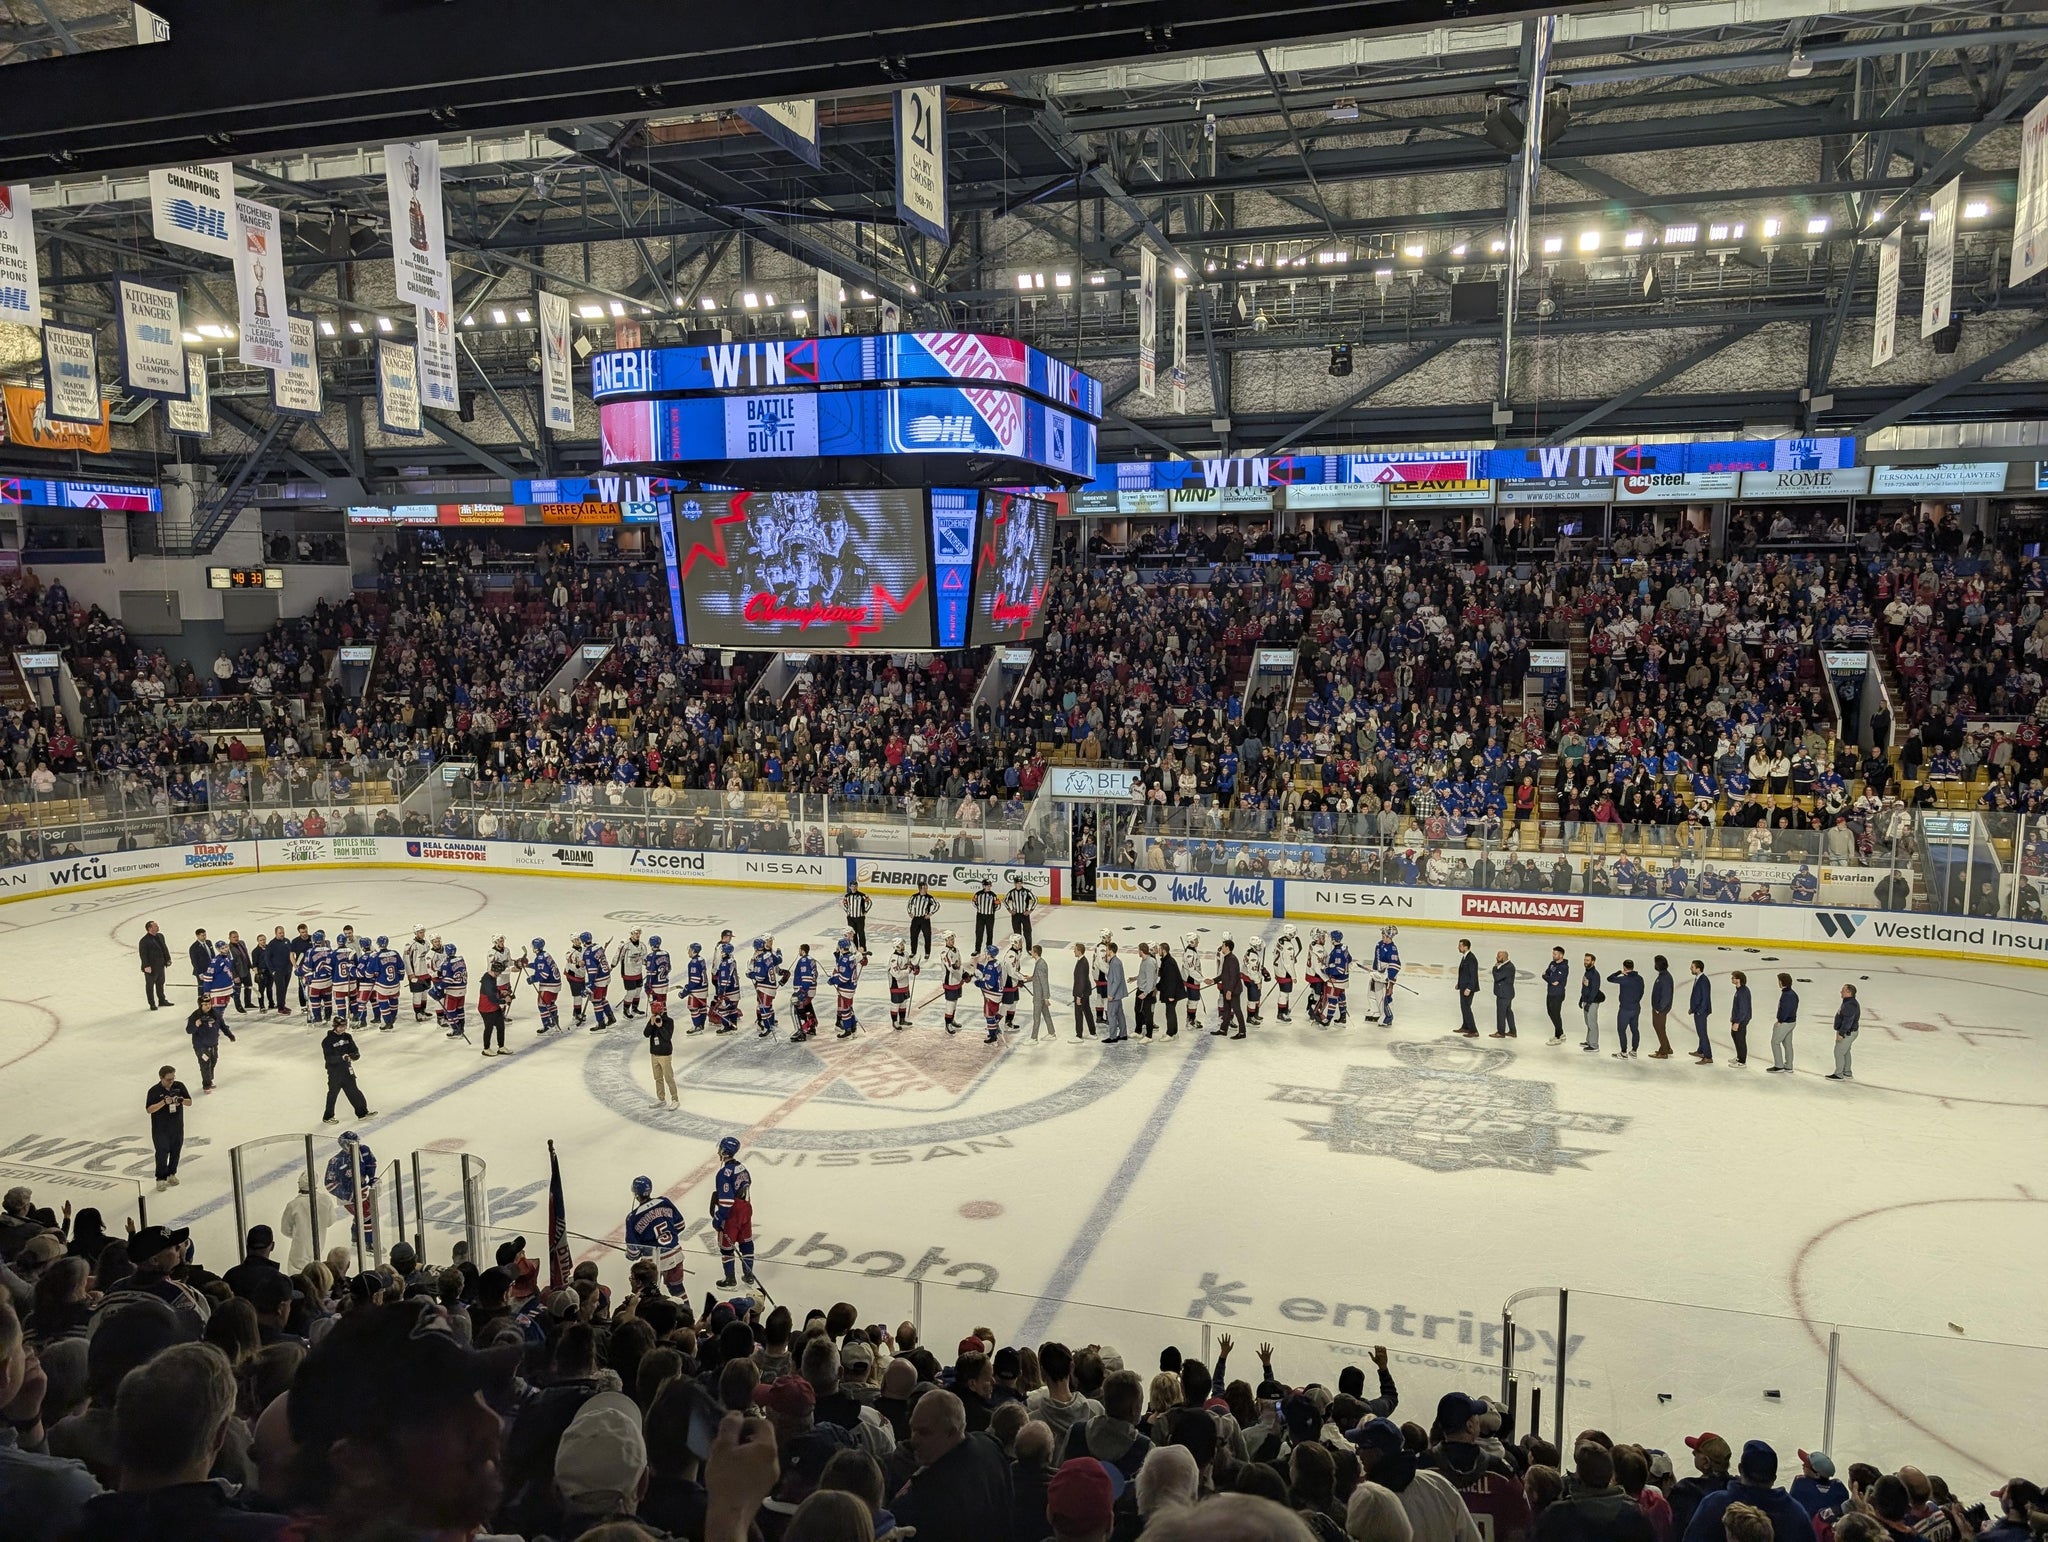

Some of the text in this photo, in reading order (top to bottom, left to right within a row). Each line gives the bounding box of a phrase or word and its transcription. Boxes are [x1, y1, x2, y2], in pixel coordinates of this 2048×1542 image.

[910, 92, 934, 157] 21
[912, 153, 932, 174] GARY
[167, 173, 221, 199] CHAMPIONS
[910, 166, 936, 194] CROSBY
[236, 202, 273, 221] KITCHENER
[239, 214, 271, 230] RANGERS
[412, 272, 434, 287] LEAGUE
[125, 289, 175, 309] KITCHENER
[407, 282, 441, 301] CHAMPIONS
[131, 303, 172, 321] RANGERS
[48, 331, 93, 348] KITCHENER
[251, 327, 276, 340] LEAGUE
[244, 335, 284, 349] CHAMPIONS
[53, 344, 89, 359] RANGERS
[136, 362, 180, 376] CHAMPIONS
[142, 355, 171, 368] LEAGUE
[708, 341, 786, 388] WIN
[63, 381, 86, 391] MAJOR
[284, 379, 310, 388] DIVISION
[1046, 355, 1070, 406] WIN
[281, 385, 316, 396] CHAMPIONS
[57, 394, 96, 406] CHAMPIONS
[746, 398, 795, 420] BATTLE
[748, 430, 796, 453] BUILT
[1539, 445, 1616, 478] WIN
[1202, 457, 1270, 488] WIN
[1652, 473, 1685, 486] steel
[1777, 472, 1832, 487] ROME
[1879, 471, 2001, 482] PERSONAL INJURY LAWYERS
[597, 476, 651, 503] WIN
[1174, 487, 1217, 503] MNP
[1310, 483, 1381, 492] MILLER THOMSON
[473, 503, 504, 512] Home
[542, 502, 617, 522] PERFEXIA.CA
[459, 516, 485, 524] building
[939, 519, 969, 528] KITCHENER
[250, 572, 262, 584] 33
[743, 592, 868, 632] Champions
[1098, 773, 1130, 790] BFL
[193, 844, 229, 856] Mary
[332, 838, 376, 847] BOTTLES MADE
[422, 842, 487, 852] REAL CANADIAN
[333, 848, 350, 856] FROM
[423, 850, 487, 862] SUPERSTORE
[563, 850, 594, 863] ADAMO
[630, 849, 705, 870] Ascend
[112, 864, 142, 873] CREDIT
[143, 862, 160, 872] UNION
[193, 861, 228, 869] CHICKEN
[515, 857, 545, 865] HOCKLEY
[746, 861, 823, 876] NISSAN
[629, 867, 705, 877] FUNDRAISING SOLUTIONS
[870, 871, 949, 888] ENBRIDGE
[952, 866, 998, 884] Carlsberg
[1823, 872, 1875, 883] Bavarian
[1315, 891, 1413, 908] NISSAN
[1466, 899, 1579, 918] PHARMASAVE
[1684, 908, 1733, 919] Oil Sands
[603, 910, 730, 927] Carlsberg
[1683, 918, 1726, 929] Alliance
[1874, 921, 1985, 945] Westland
[1362, 1108, 1526, 1135] CUP
[744, 1134, 1016, 1169] NISSAN
[1350, 1140, 1536, 1167] NISSAN
[47, 1175, 119, 1191] UNION
[653, 1221, 674, 1246] 5
[1279, 1296, 1586, 1367] entripy
